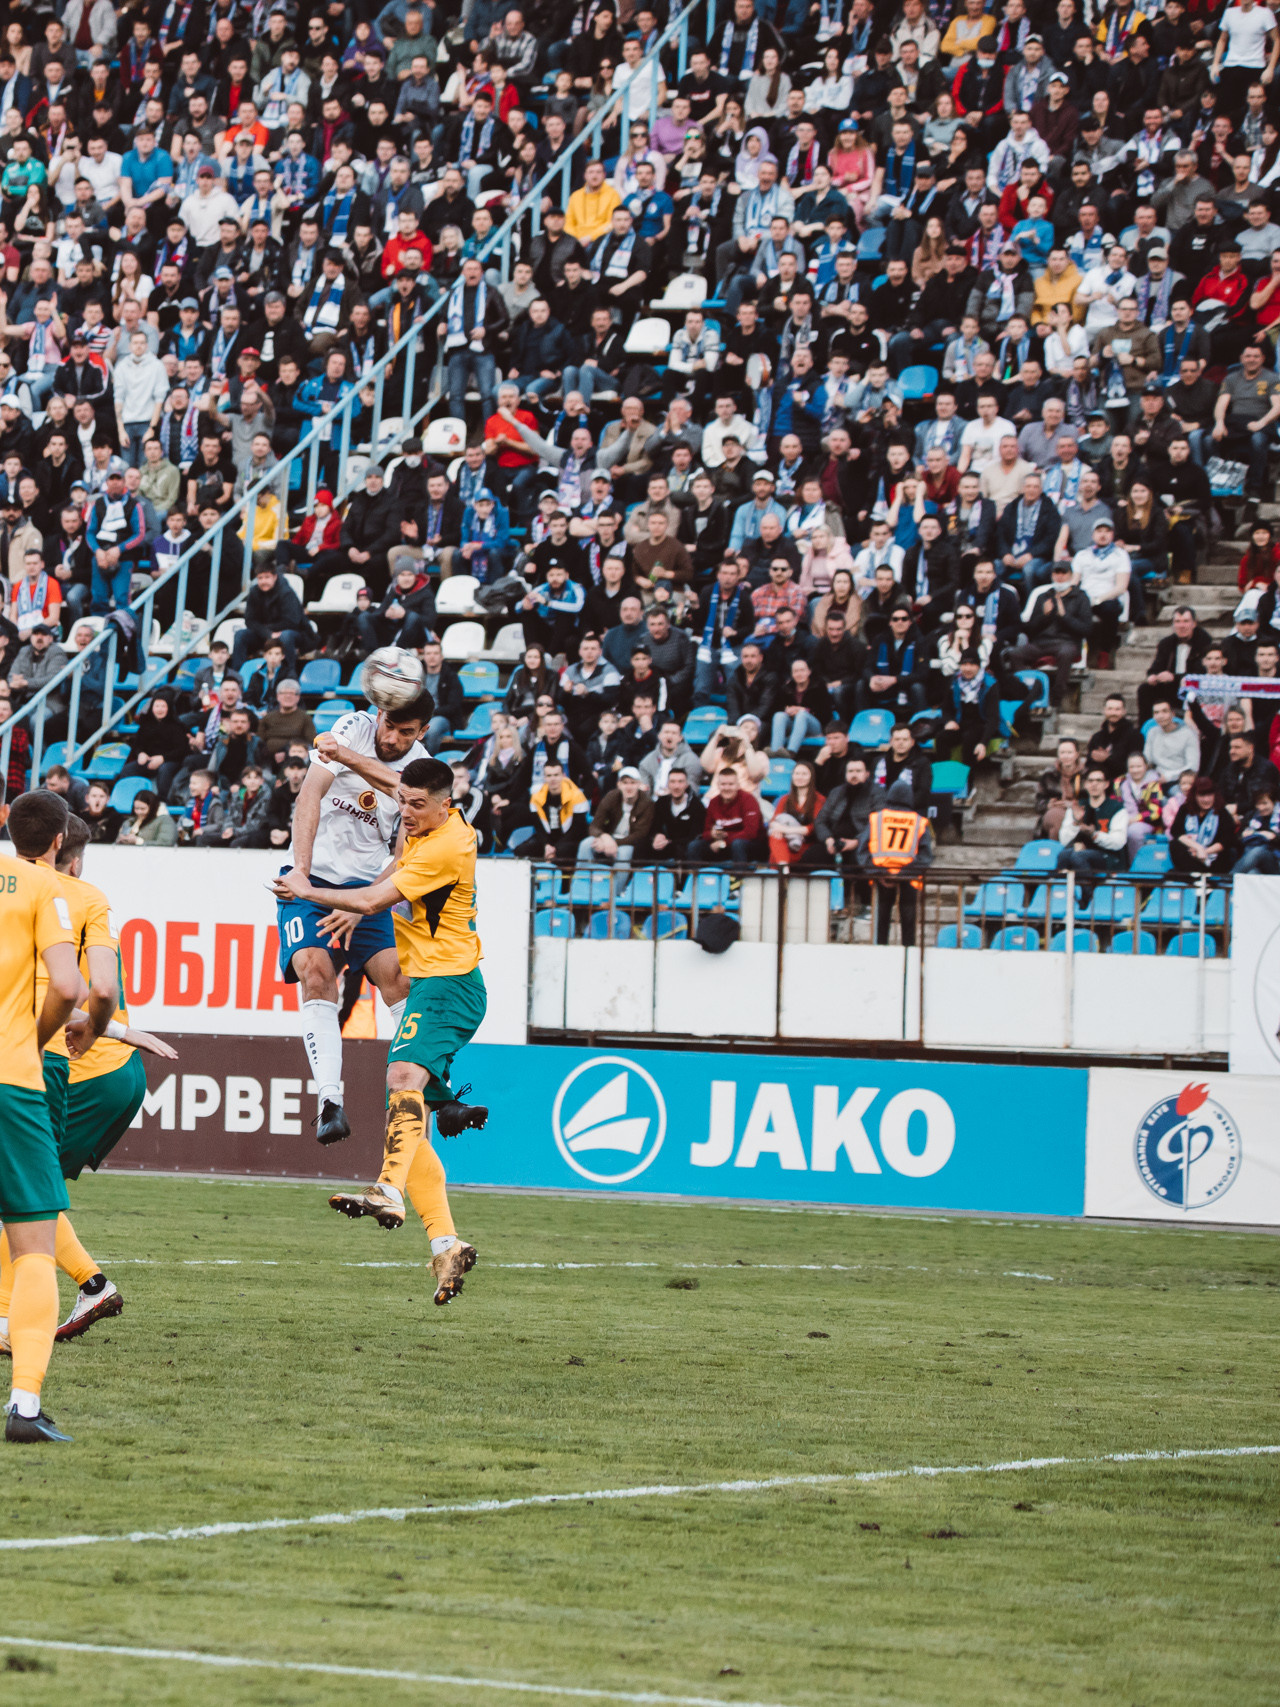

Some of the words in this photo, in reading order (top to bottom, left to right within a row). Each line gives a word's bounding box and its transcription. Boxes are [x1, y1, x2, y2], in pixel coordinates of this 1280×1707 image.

[331, 797, 380, 829] OLIMPBE
[887, 826, 910, 849] 77
[283, 916, 305, 949] 10
[120, 917, 300, 1012] ОБЛА
[395, 1012, 423, 1045] 5
[690, 1080, 957, 1178] JAKO
